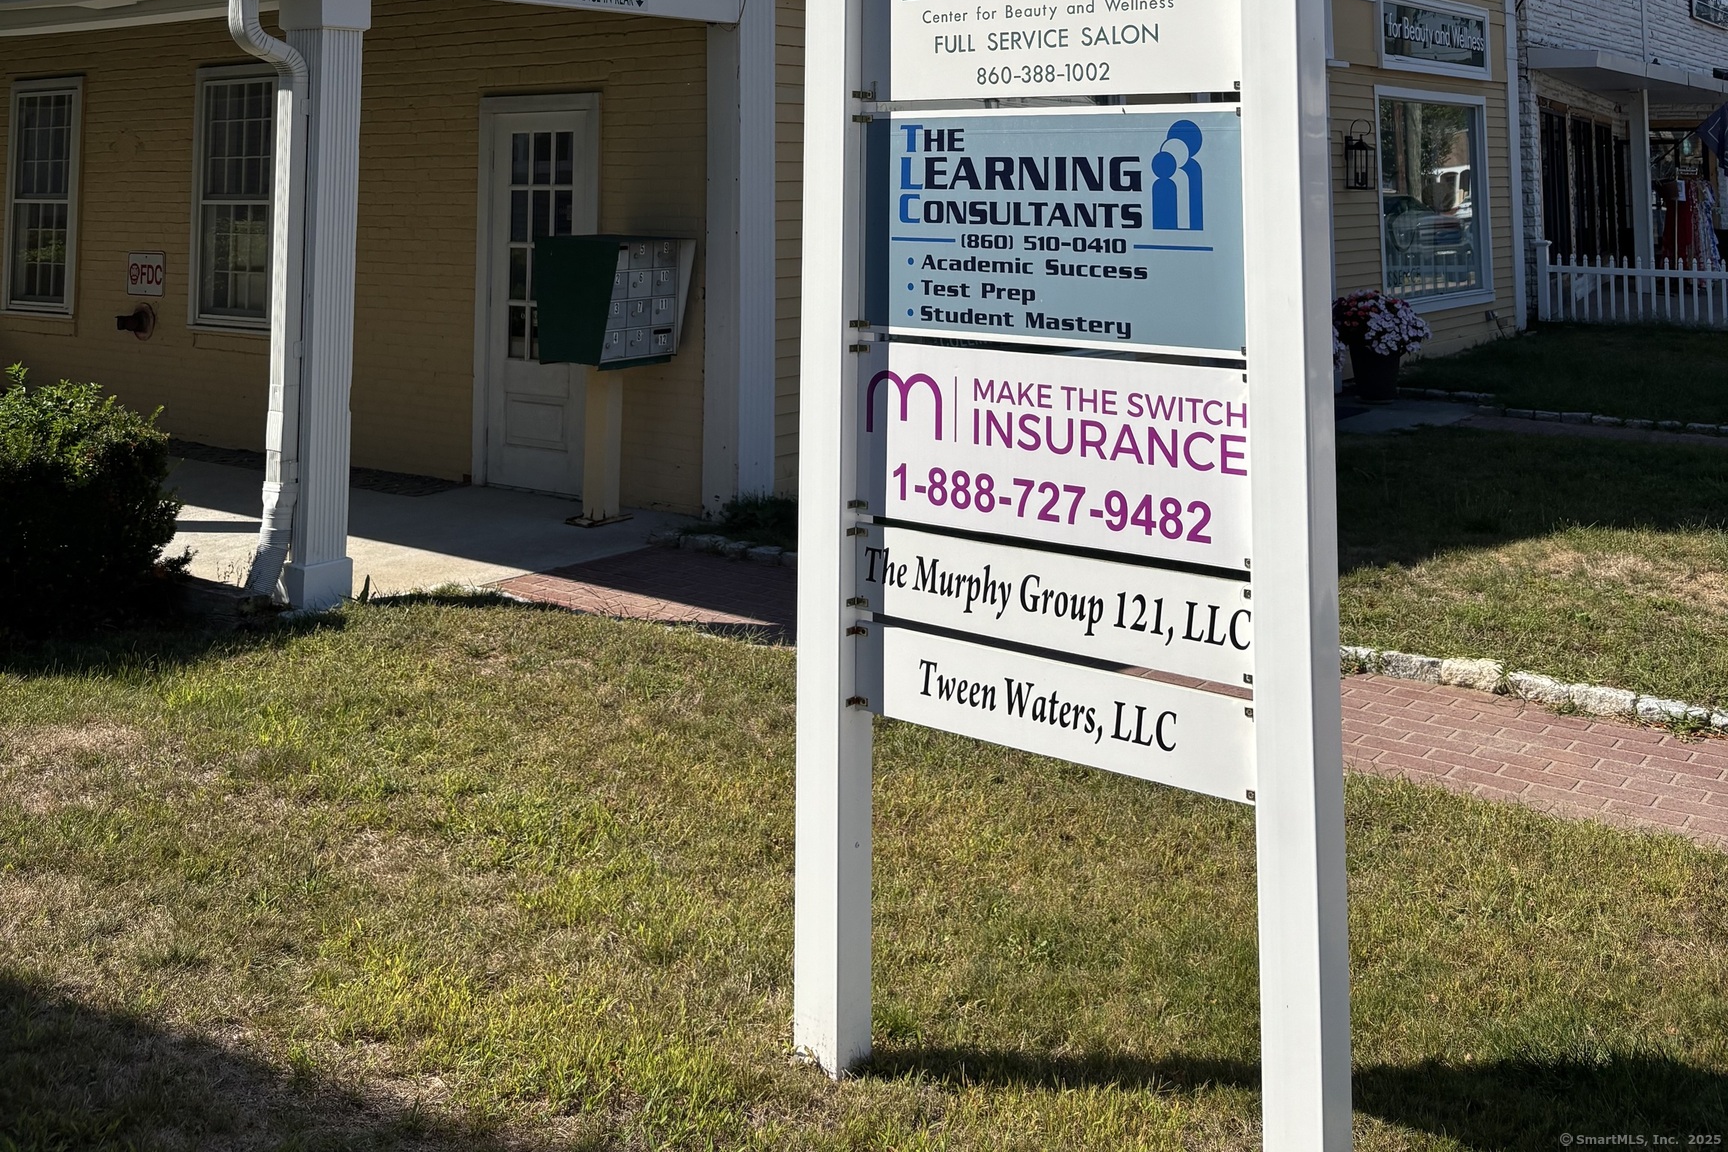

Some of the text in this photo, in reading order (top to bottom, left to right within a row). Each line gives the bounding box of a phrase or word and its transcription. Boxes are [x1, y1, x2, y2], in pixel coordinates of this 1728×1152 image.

[922, 8, 968, 24] Center
[975, 4, 998, 21] for
[1004, 0, 1058, 22] Beauty
[934, 23, 1160, 54] FULL SERVICE SALON
[1388, 12, 1484, 51] for Beauty and Wellness
[976, 62, 1110, 85] 860-388-1002
[900, 155, 1143, 193] LEARNING
[899, 193, 1143, 229] CONSULTANTS
[960, 233, 1127, 254] (860) 510-0410
[140, 264, 162, 285] FDC
[921, 254, 1148, 280] Academic Success
[921, 279, 1036, 306] Test Prep
[920, 305, 1131, 339] Student Mastery
[973, 377, 1247, 429] MAKE THE SWITCH
[972, 408, 1248, 477] INSURANCE
[892, 462, 1213, 545] 1-888-727-9482
[864, 547, 1251, 651] The Murphy Group 121, LLC
[919, 658, 1178, 752] Tween Waters, LLC
